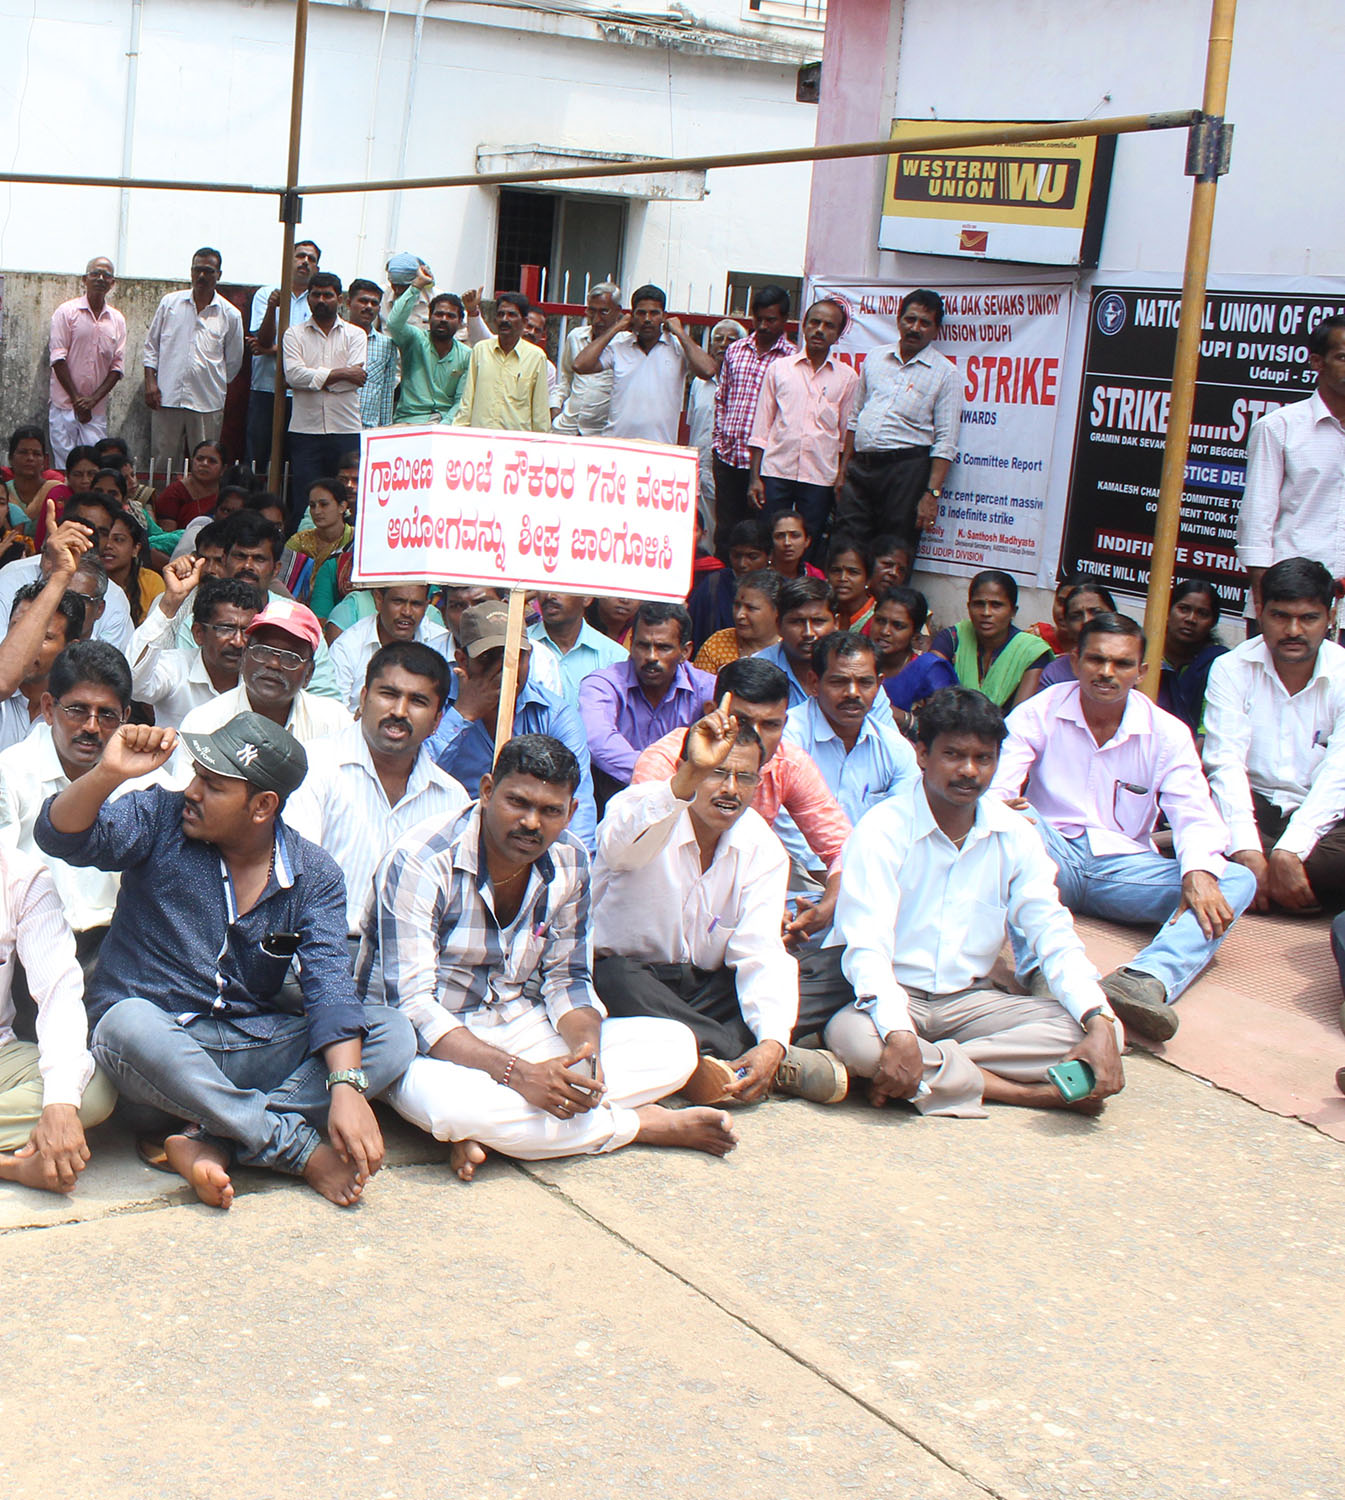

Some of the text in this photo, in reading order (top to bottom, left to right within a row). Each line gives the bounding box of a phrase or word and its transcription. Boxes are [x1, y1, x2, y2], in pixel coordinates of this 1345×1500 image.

[902, 159, 997, 180] WESTERN
[928, 179, 996, 199] UNION
[1009, 163, 1069, 203] WU
[859, 295, 877, 315] ALL
[960, 295, 981, 316] DAK
[983, 295, 1025, 316] SEVAKS
[1027, 294, 1062, 316] UNION
[1219, 302, 1277, 334] UNION
[1278, 304, 1305, 335] OF
[978, 325, 1012, 343] UDUPI
[1199, 341, 1310, 364] UPI DIVISIO
[964, 355, 1059, 407] STRIKE
[1249, 366, 1289, 384] Udupi
[1090, 432, 1120, 445] GRAMIN
[1121, 435, 1138, 447] DAK
[1139, 437, 1166, 449] SEVAK
[1190, 443, 1208, 455] NOT
[963, 452, 1009, 469] Committee
[1011, 457, 1043, 473] Report
[370, 450, 690, 513] ಗ್ರಾಮೀಣ ಅಂಚೆ ನೌಕರರ 7ನೇ ವೇತನ
[1184, 465, 1218, 482] STICE
[1097, 481, 1139, 495] KAMALESH
[955, 491, 974, 502] cent
[975, 492, 1008, 507] percent
[1180, 492, 1230, 508] COMMITTEE
[948, 506, 988, 522] indefinite
[989, 511, 1014, 526] strike
[1203, 511, 1227, 522] TOOK
[387, 506, 673, 572] ಆಯೋಗವನ್ನು ಶೀಘ್ರ ಜಾರಿಗೊಳಿಸಿ
[967, 529, 998, 544] Santhosh
[999, 532, 1036, 548] Madhyasta
[1180, 522, 1216, 537] WAITING
[932, 546, 955, 558] UDUPI
[955, 549, 984, 563] DIVISION
[1193, 551, 1248, 574] STRIK
[1077, 559, 1151, 584] STRIKE WILL NO
